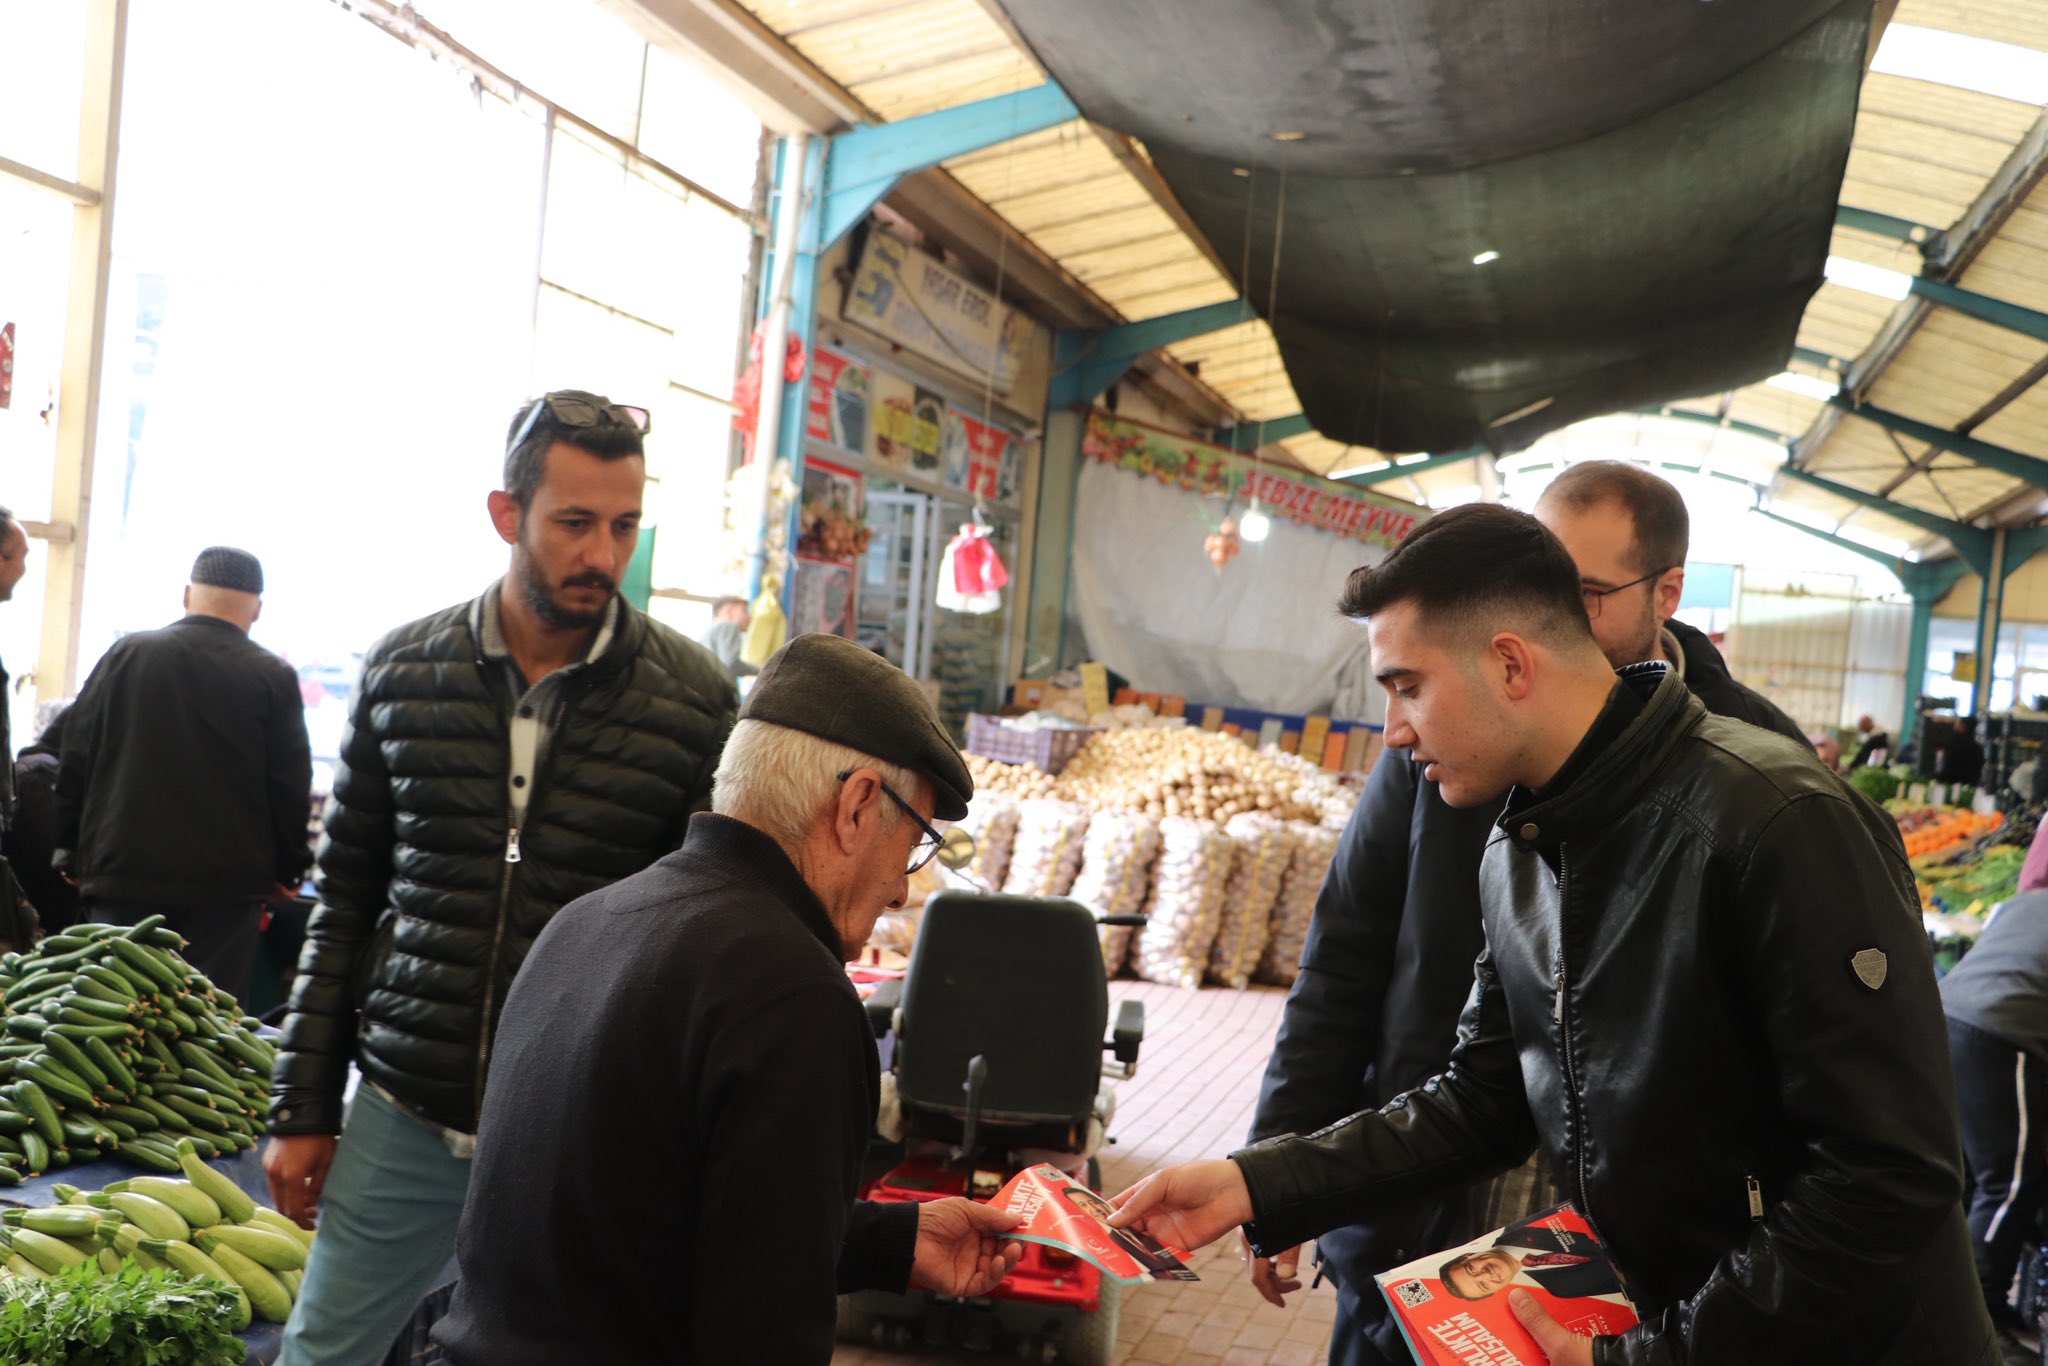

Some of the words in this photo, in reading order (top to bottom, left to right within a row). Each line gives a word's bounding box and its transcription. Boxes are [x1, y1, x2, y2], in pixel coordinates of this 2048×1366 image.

[1238, 468, 1322, 514] SEBZE
[1322, 493, 1418, 542] MEYVE
[1005, 1179, 1037, 1214] RLİKTE
[1427, 1319, 1500, 1366] RLİKTE
[1449, 1312, 1527, 1366] ALIŞALIM
[1599, 1315, 1611, 1335] ONYA
